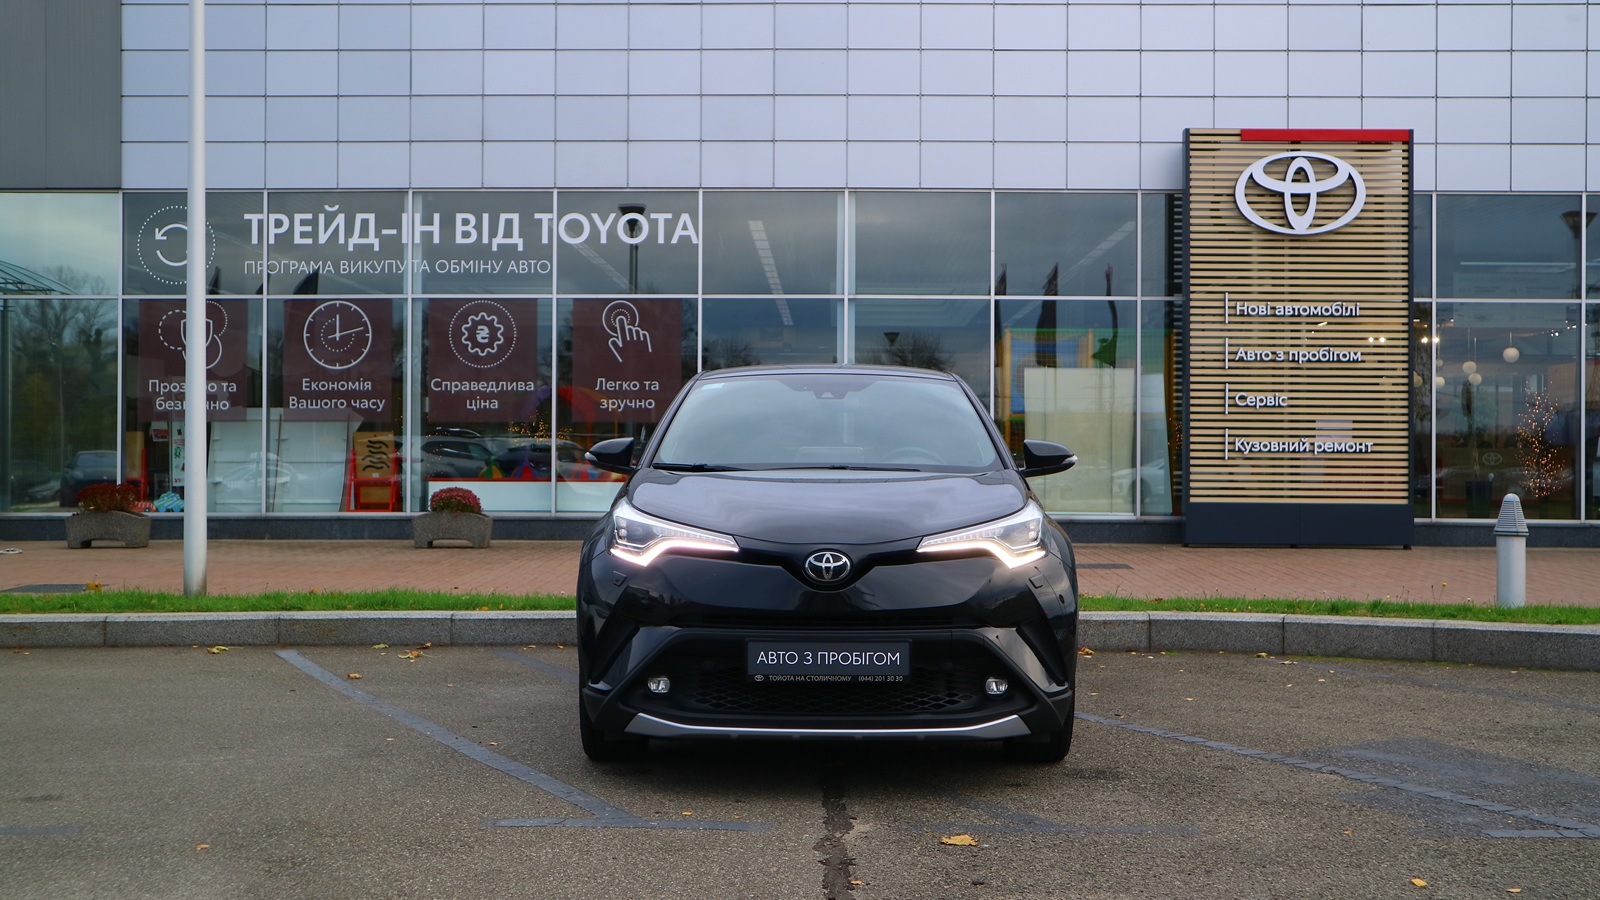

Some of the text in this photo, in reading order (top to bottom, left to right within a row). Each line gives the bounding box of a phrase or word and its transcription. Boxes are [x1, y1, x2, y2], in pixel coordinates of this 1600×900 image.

[243, 204, 699, 252] ТРЕЙД-ІН ВІД TOYOTA
[244, 260, 551, 274] ПРОГРАМА ВИКУПУ ТА ОБМІНУ АВТО
[1235, 302, 1361, 317] Нові автомобілі
[1235, 347, 1362, 364] Авто з пробігом
[148, 379, 237, 395] Прозо та
[302, 377, 372, 392] Економія
[430, 378, 535, 393] Справедлива
[595, 377, 660, 392] Легко та
[155, 396, 230, 410] безно
[289, 396, 386, 412] Вашого часу
[466, 397, 499, 411] ціна
[599, 398, 656, 412] зручно
[1235, 392, 1289, 409] Сервіс
[1235, 437, 1374, 456] Кузовний ремонт
[756, 651, 901, 666] АВТО З ПРОБІГОМ
[768, 674, 795, 682] ТОЙОТА
